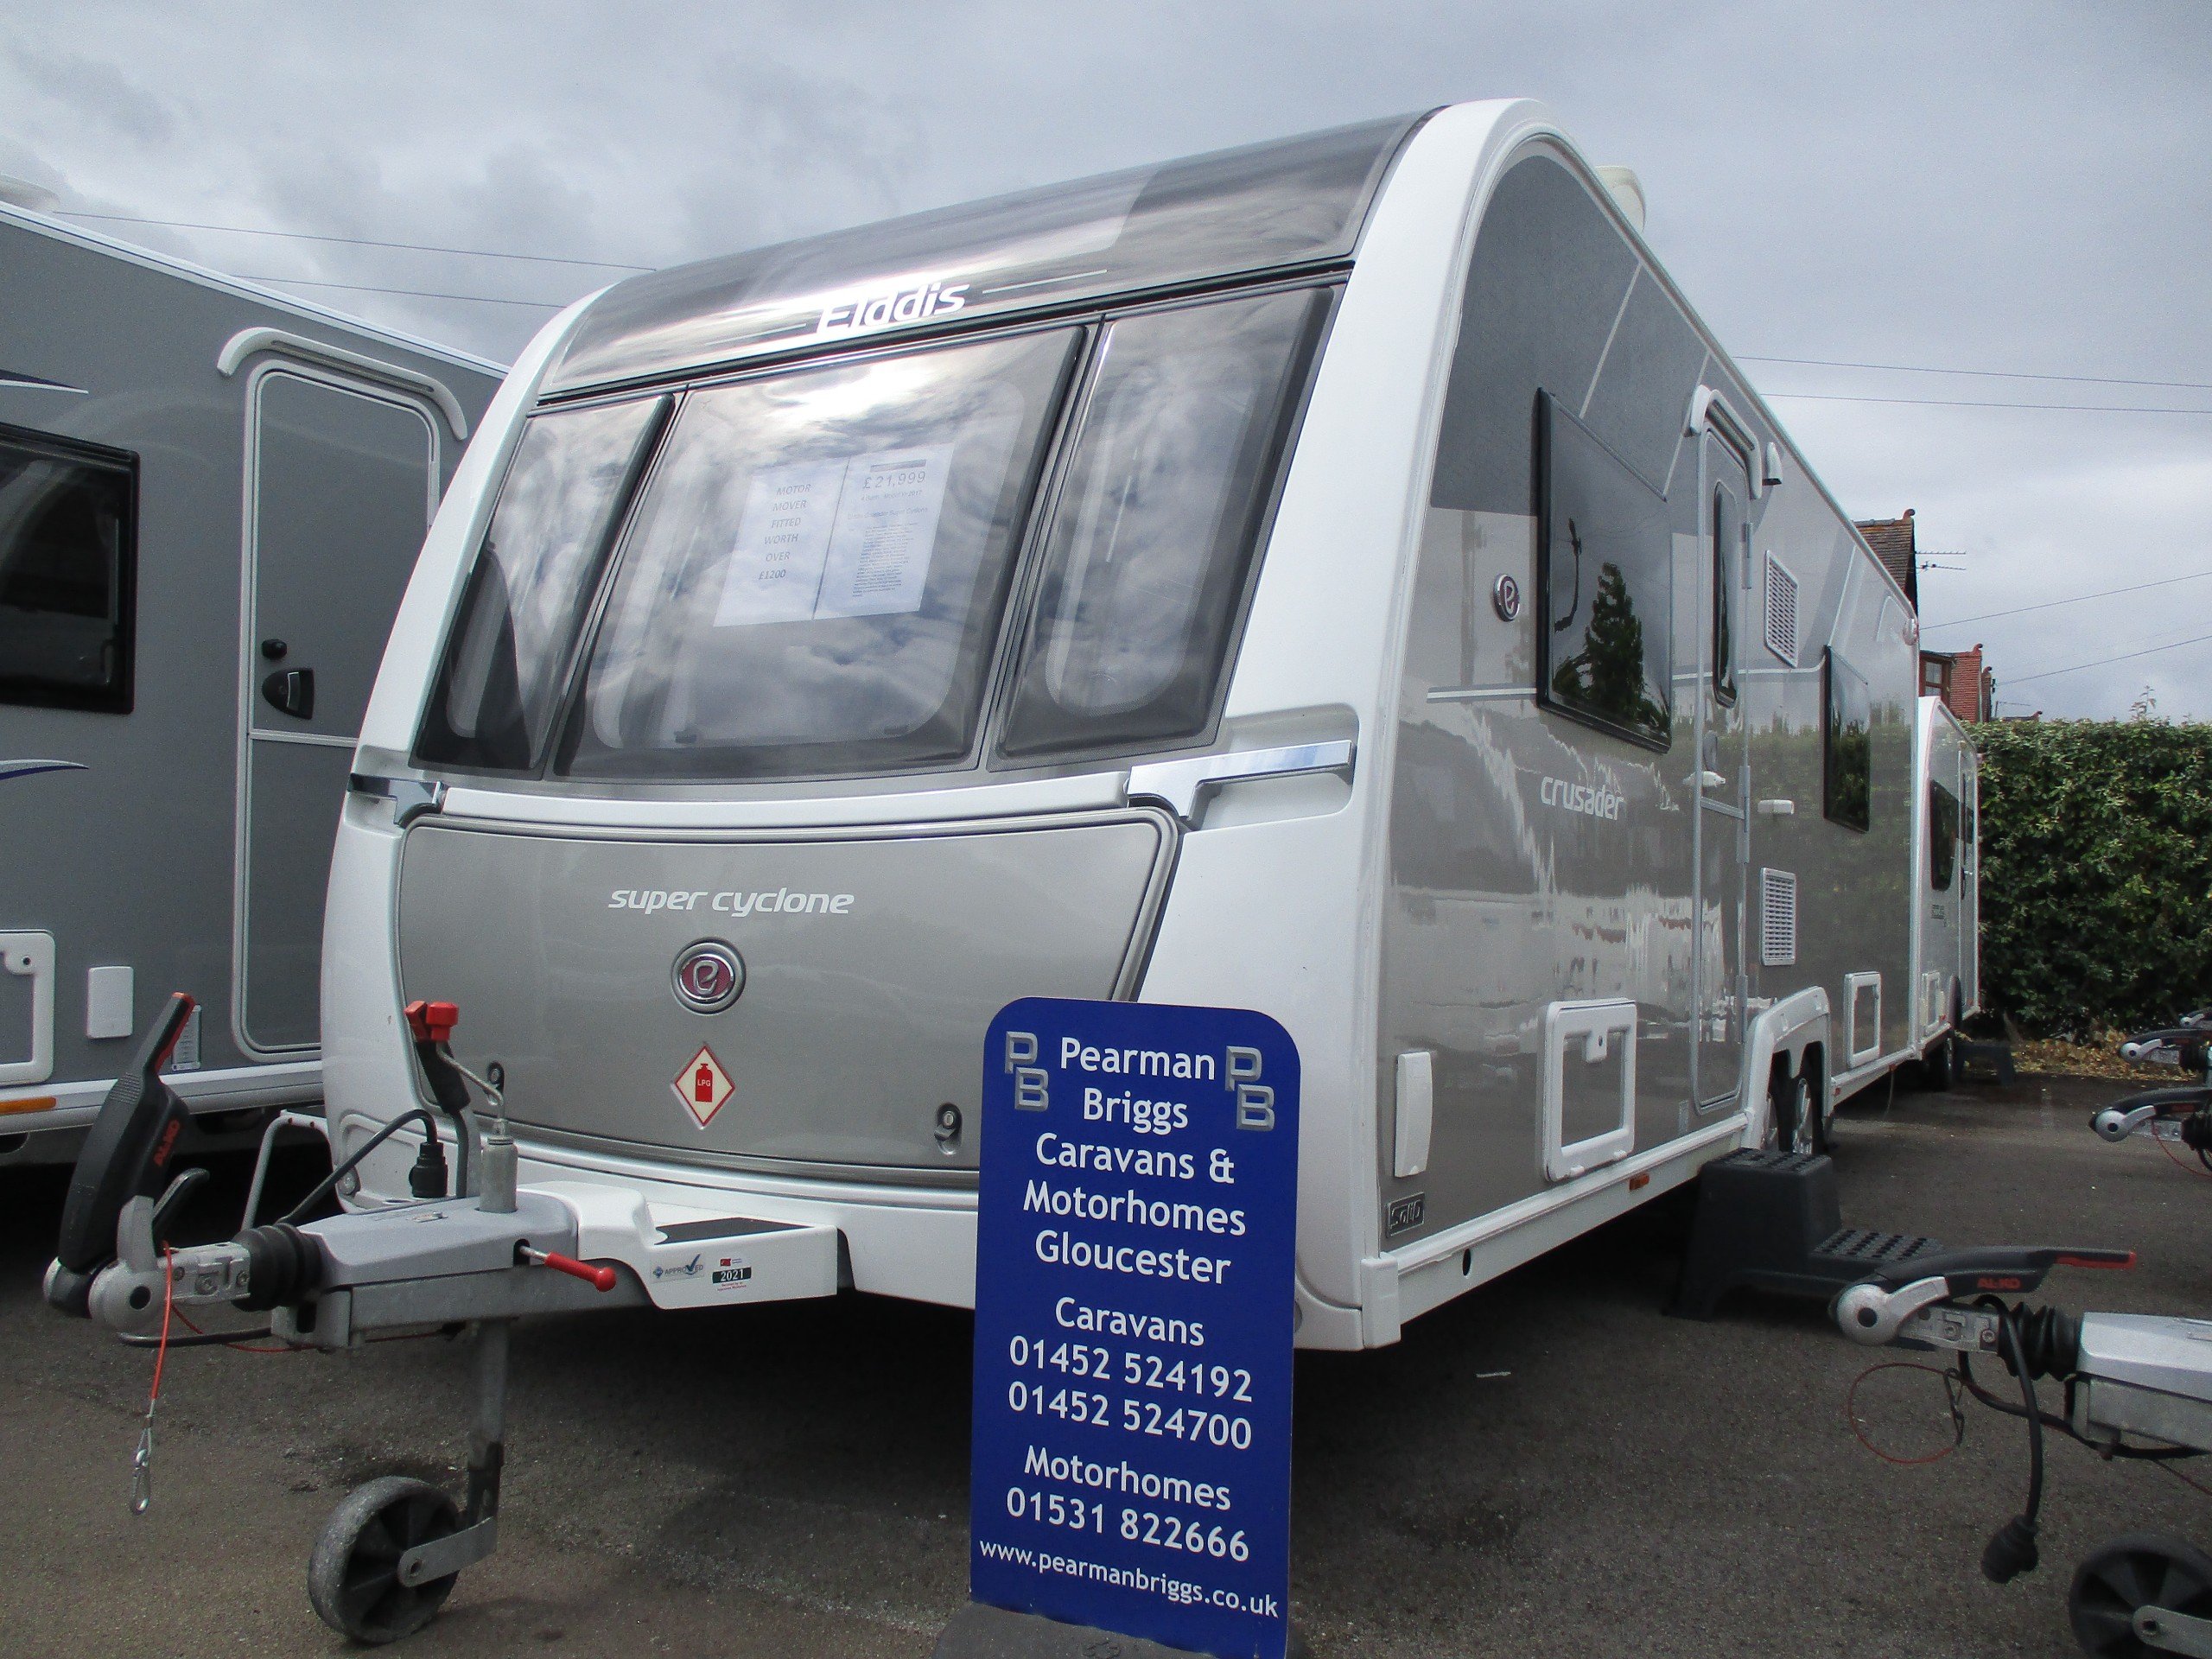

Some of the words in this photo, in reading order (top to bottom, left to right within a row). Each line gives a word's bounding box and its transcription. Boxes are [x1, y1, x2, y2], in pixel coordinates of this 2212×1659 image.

[817, 283, 970, 334] Elddis
[777, 483, 811, 495] MOTOR
[862, 471, 926, 490] £21,999
[771, 518, 802, 529] FITTED
[773, 499, 807, 512] MOVER
[764, 533, 799, 545] WORTH
[766, 551, 791, 563] OVER
[758, 569, 786, 581] £1200
[1541, 776, 1624, 821] crusader
[608, 889, 709, 915] super
[711, 887, 855, 918] cyclone
[1059, 1037, 1216, 1081] Pearman
[1083, 1087, 1189, 1135] Briggs
[1035, 1132, 1195, 1181] Caravans
[1209, 1147, 1236, 1184] &
[1023, 1179, 1247, 1236] Motorhomes
[720, 1268, 743, 1282] 2021
[1035, 1230, 1232, 1285] Gloucester
[1055, 1296, 1205, 1347] Caravans
[1009, 1335, 1111, 1380] 01452
[1124, 1351, 1253, 1403] 524192
[1007, 1381, 1110, 1427] 01452
[1123, 1399, 1252, 1450] 524700
[1024, 1445, 1231, 1511] Motorhomes
[1006, 1486, 1104, 1535] 01531
[1121, 1508, 1249, 1562] 822666
[979, 1540, 1279, 1619] www.pearmanbriggs.co.uk
